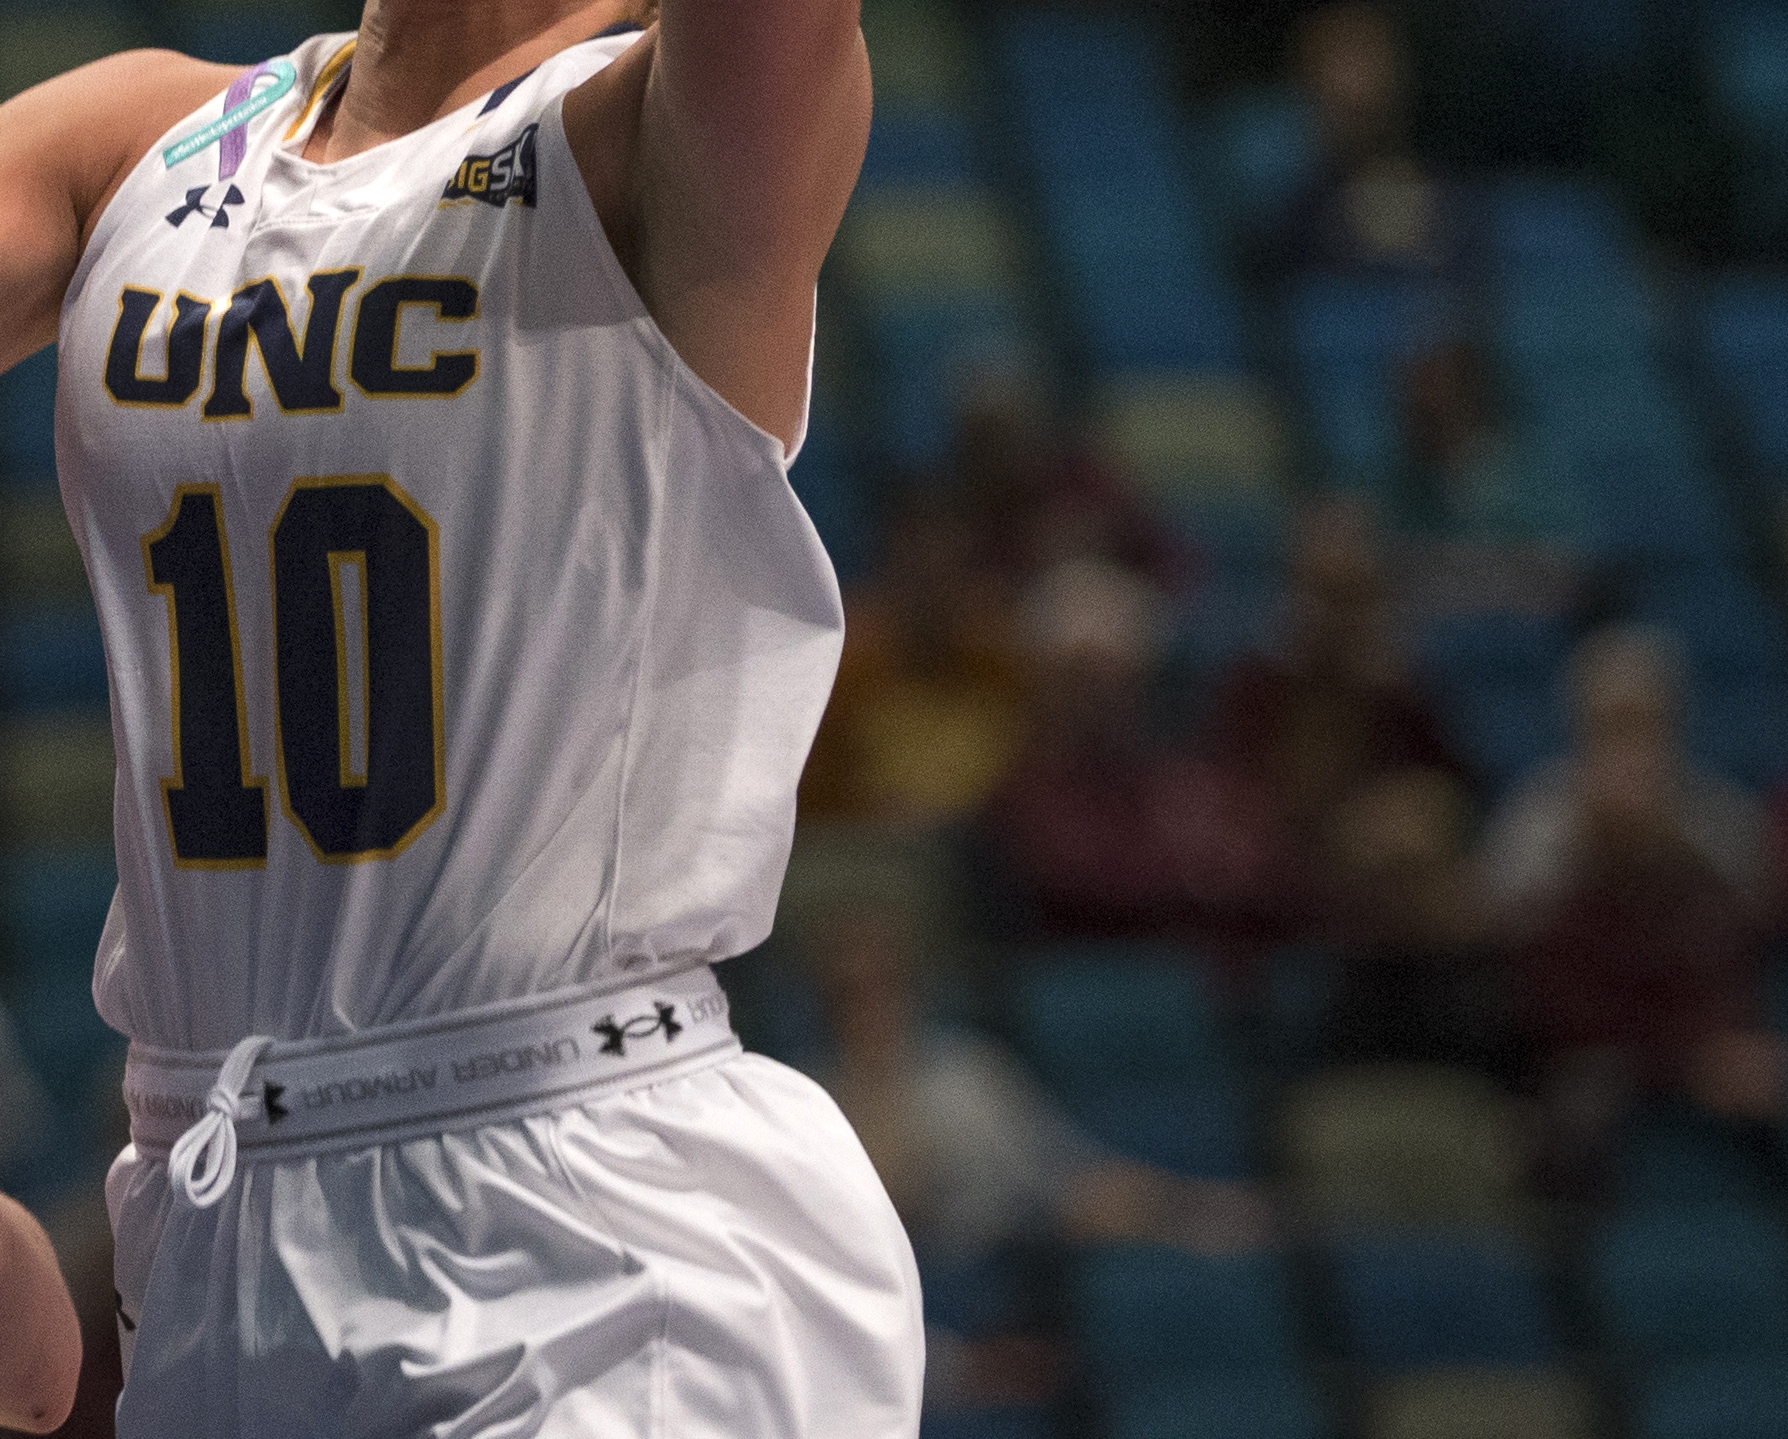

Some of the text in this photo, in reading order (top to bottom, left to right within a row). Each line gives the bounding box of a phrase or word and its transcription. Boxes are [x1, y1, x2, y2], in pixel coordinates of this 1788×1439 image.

[102, 266, 481, 422] UNC
[140, 473, 447, 870] 10
[303, 1034, 582, 1110] UNDER ARMOUR
